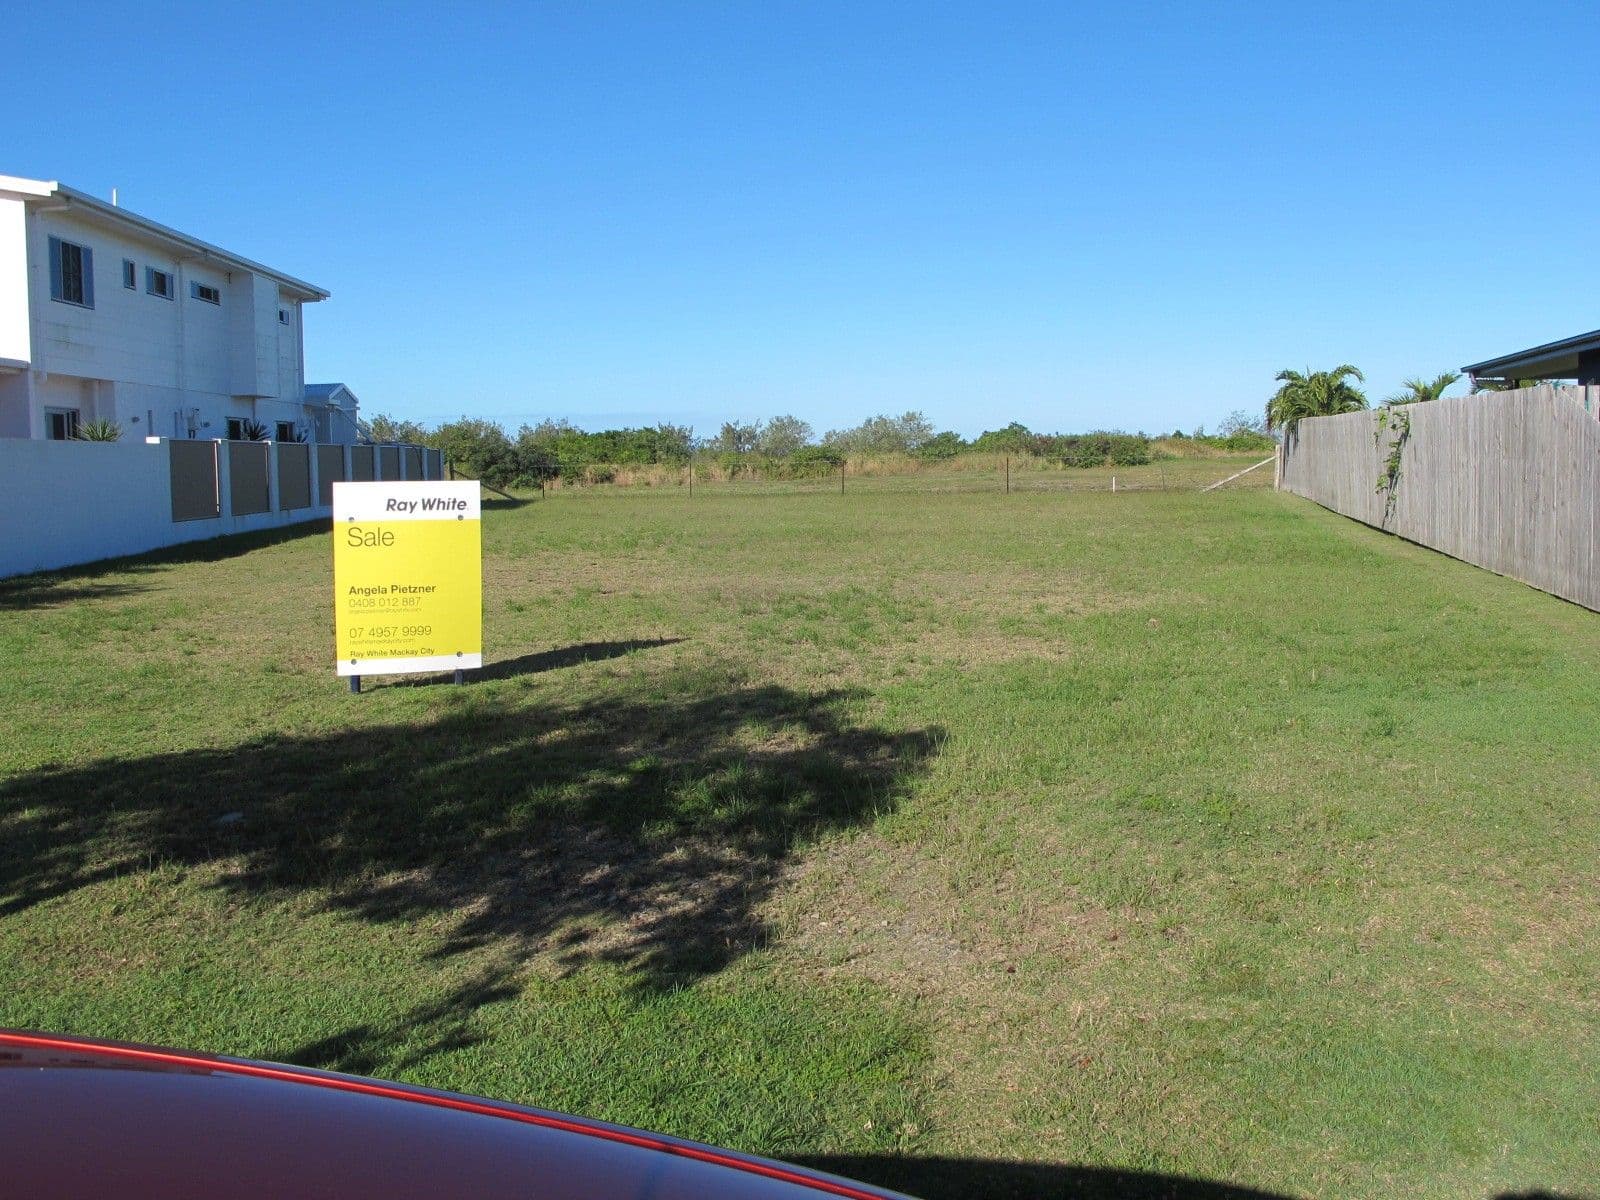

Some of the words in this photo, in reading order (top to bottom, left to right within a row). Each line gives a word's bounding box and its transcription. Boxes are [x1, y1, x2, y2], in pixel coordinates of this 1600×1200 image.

[386, 498, 418, 514] Ray
[422, 497, 467, 511] White
[347, 526, 395, 548] Sale
[349, 585, 388, 597] Angela
[391, 584, 437, 594] Pietzner
[349, 598, 376, 608] 0408
[378, 597, 399, 608] 012
[402, 597, 422, 607] 887
[349, 627, 365, 639] 07
[368, 626, 399, 638] 4957
[402, 625, 432, 636] 9999
[350, 650, 364, 658] Ray
[366, 649, 388, 657] White
[390, 648, 419, 657] Mackay
[420, 647, 435, 656] City
